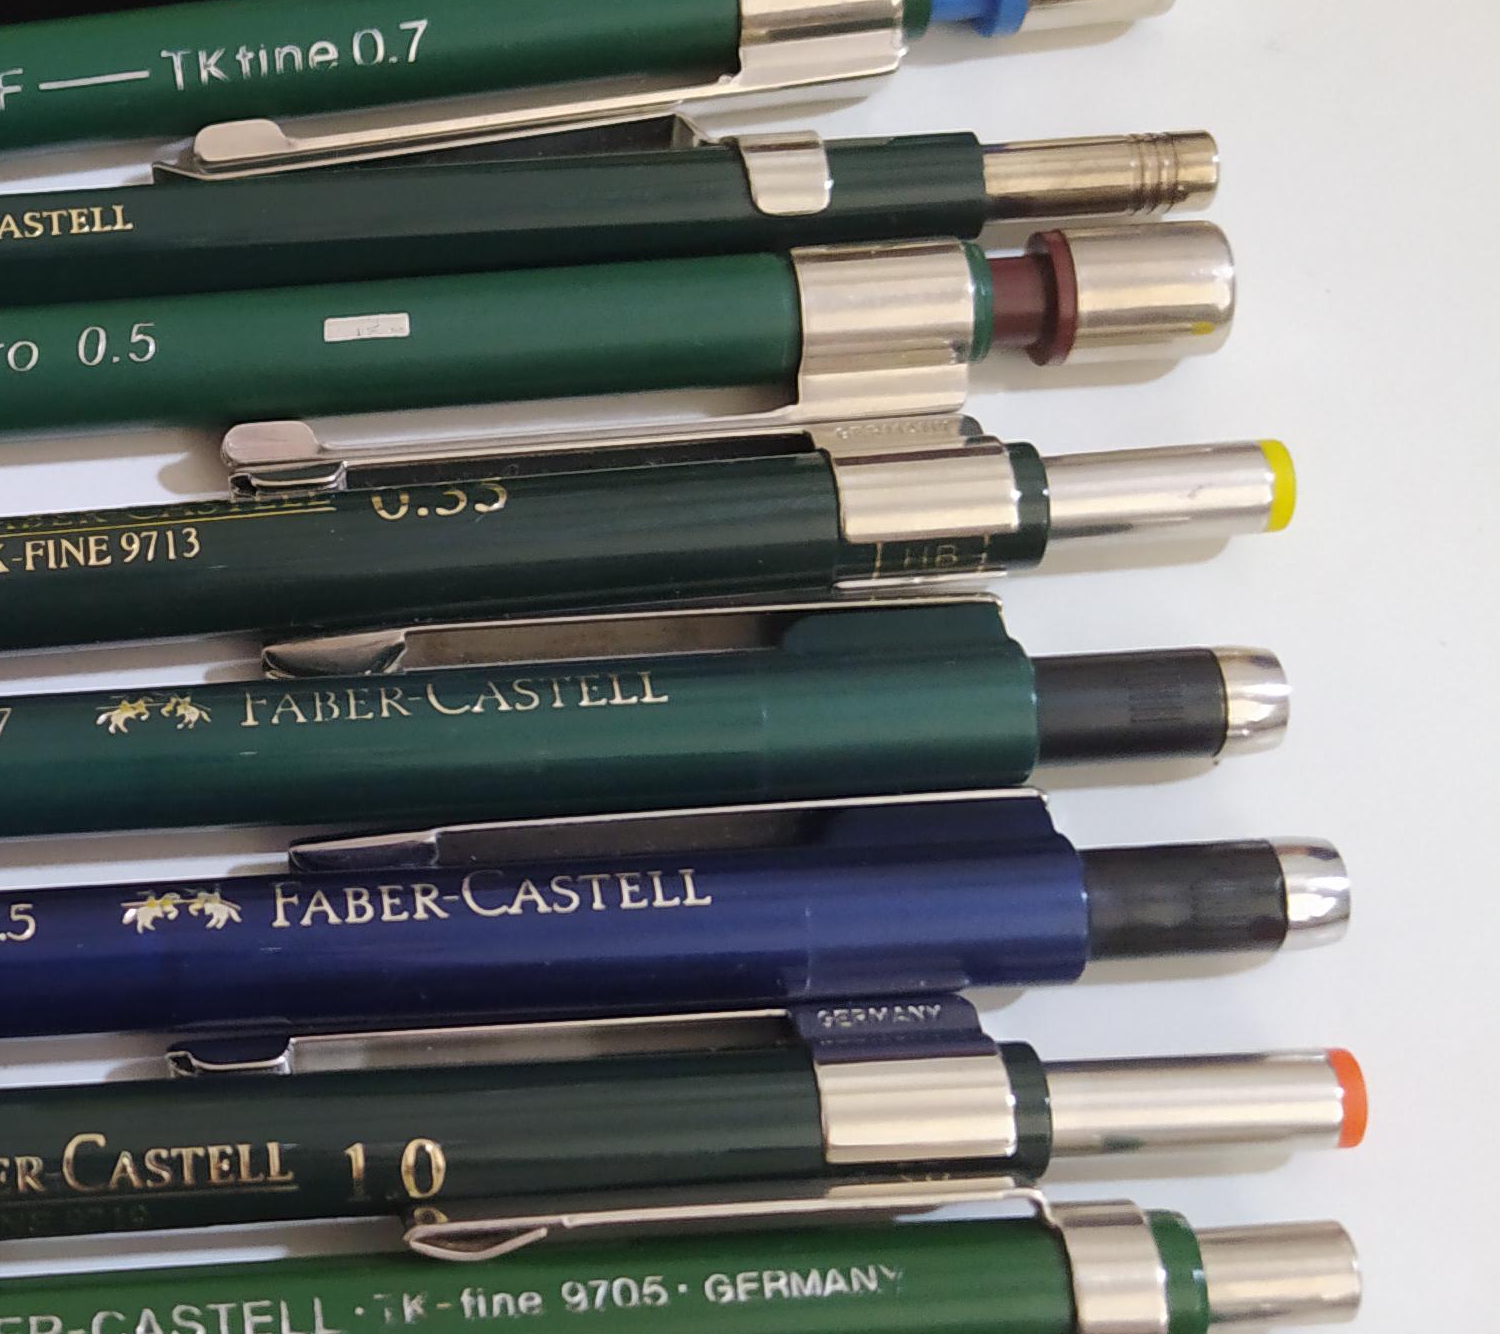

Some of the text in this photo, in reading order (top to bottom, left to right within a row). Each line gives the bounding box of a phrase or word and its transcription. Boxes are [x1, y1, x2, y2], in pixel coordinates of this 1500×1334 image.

[351, 18, 431, 67] 0.7
[77, 322, 158, 367] 0.5
[120, 526, 201, 564] 9713
[240, 670, 669, 727] FABER-CASTELL
[270, 868, 713, 929] FABER-CASTELL
[816, 1002, 942, 1028] GERMANY
[560, 1275, 669, 1315] 9705
